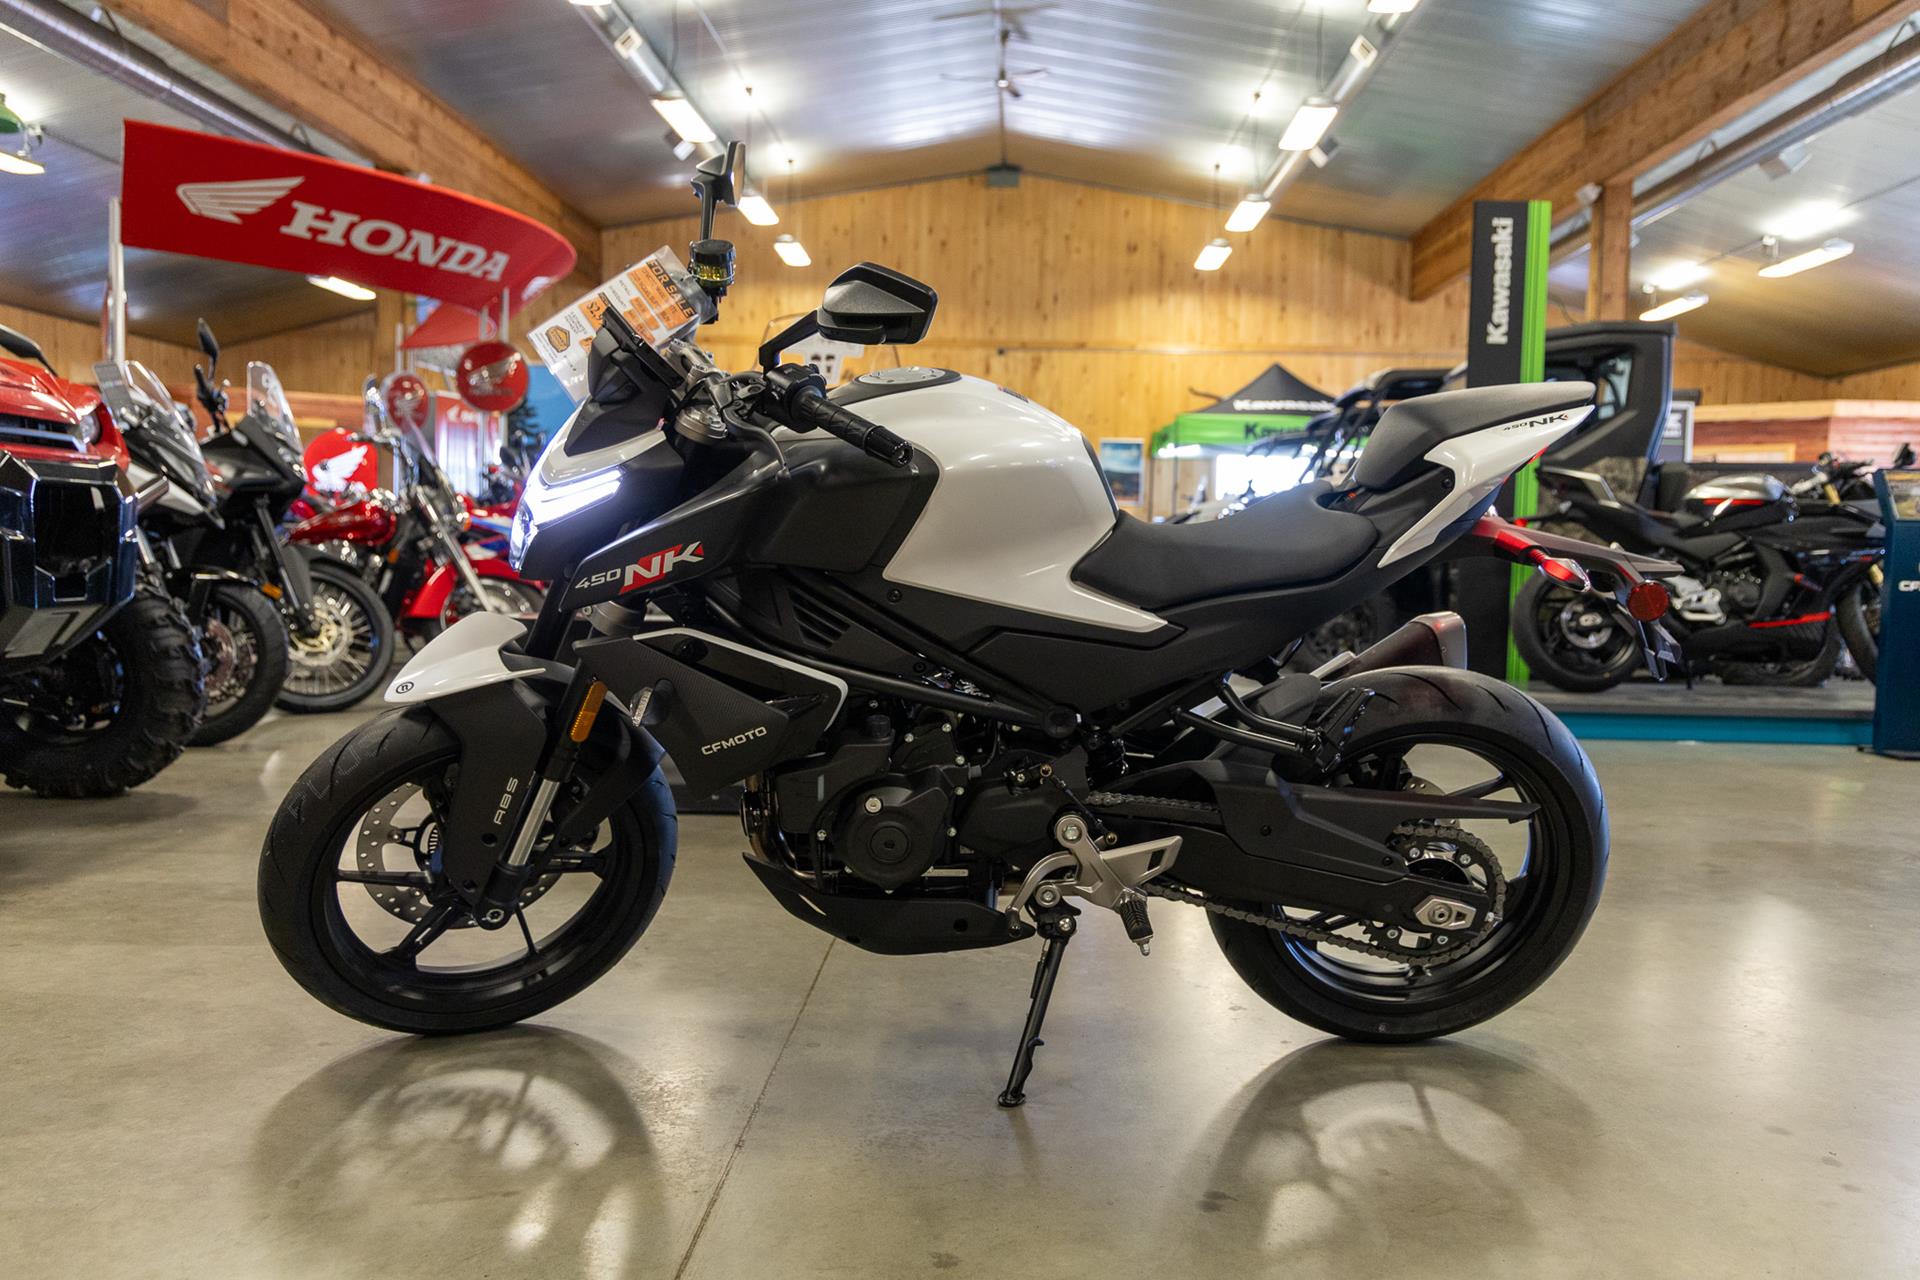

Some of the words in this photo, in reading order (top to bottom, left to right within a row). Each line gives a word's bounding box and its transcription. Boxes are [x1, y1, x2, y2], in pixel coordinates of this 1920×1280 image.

[280, 201, 510, 281] HONDA
[648, 259, 669, 284] FOR
[666, 283, 696, 318] SALE
[1486, 217, 1514, 345] Kawasaki
[1233, 399, 1336, 413] Kawasak
[1529, 414, 1566, 428] NK
[575, 568, 621, 589] 450
[624, 541, 704, 587] NK
[1898, 580, 1920, 592] CF
[701, 726, 768, 755] CFMOTO
[494, 776, 519, 825] ABS
